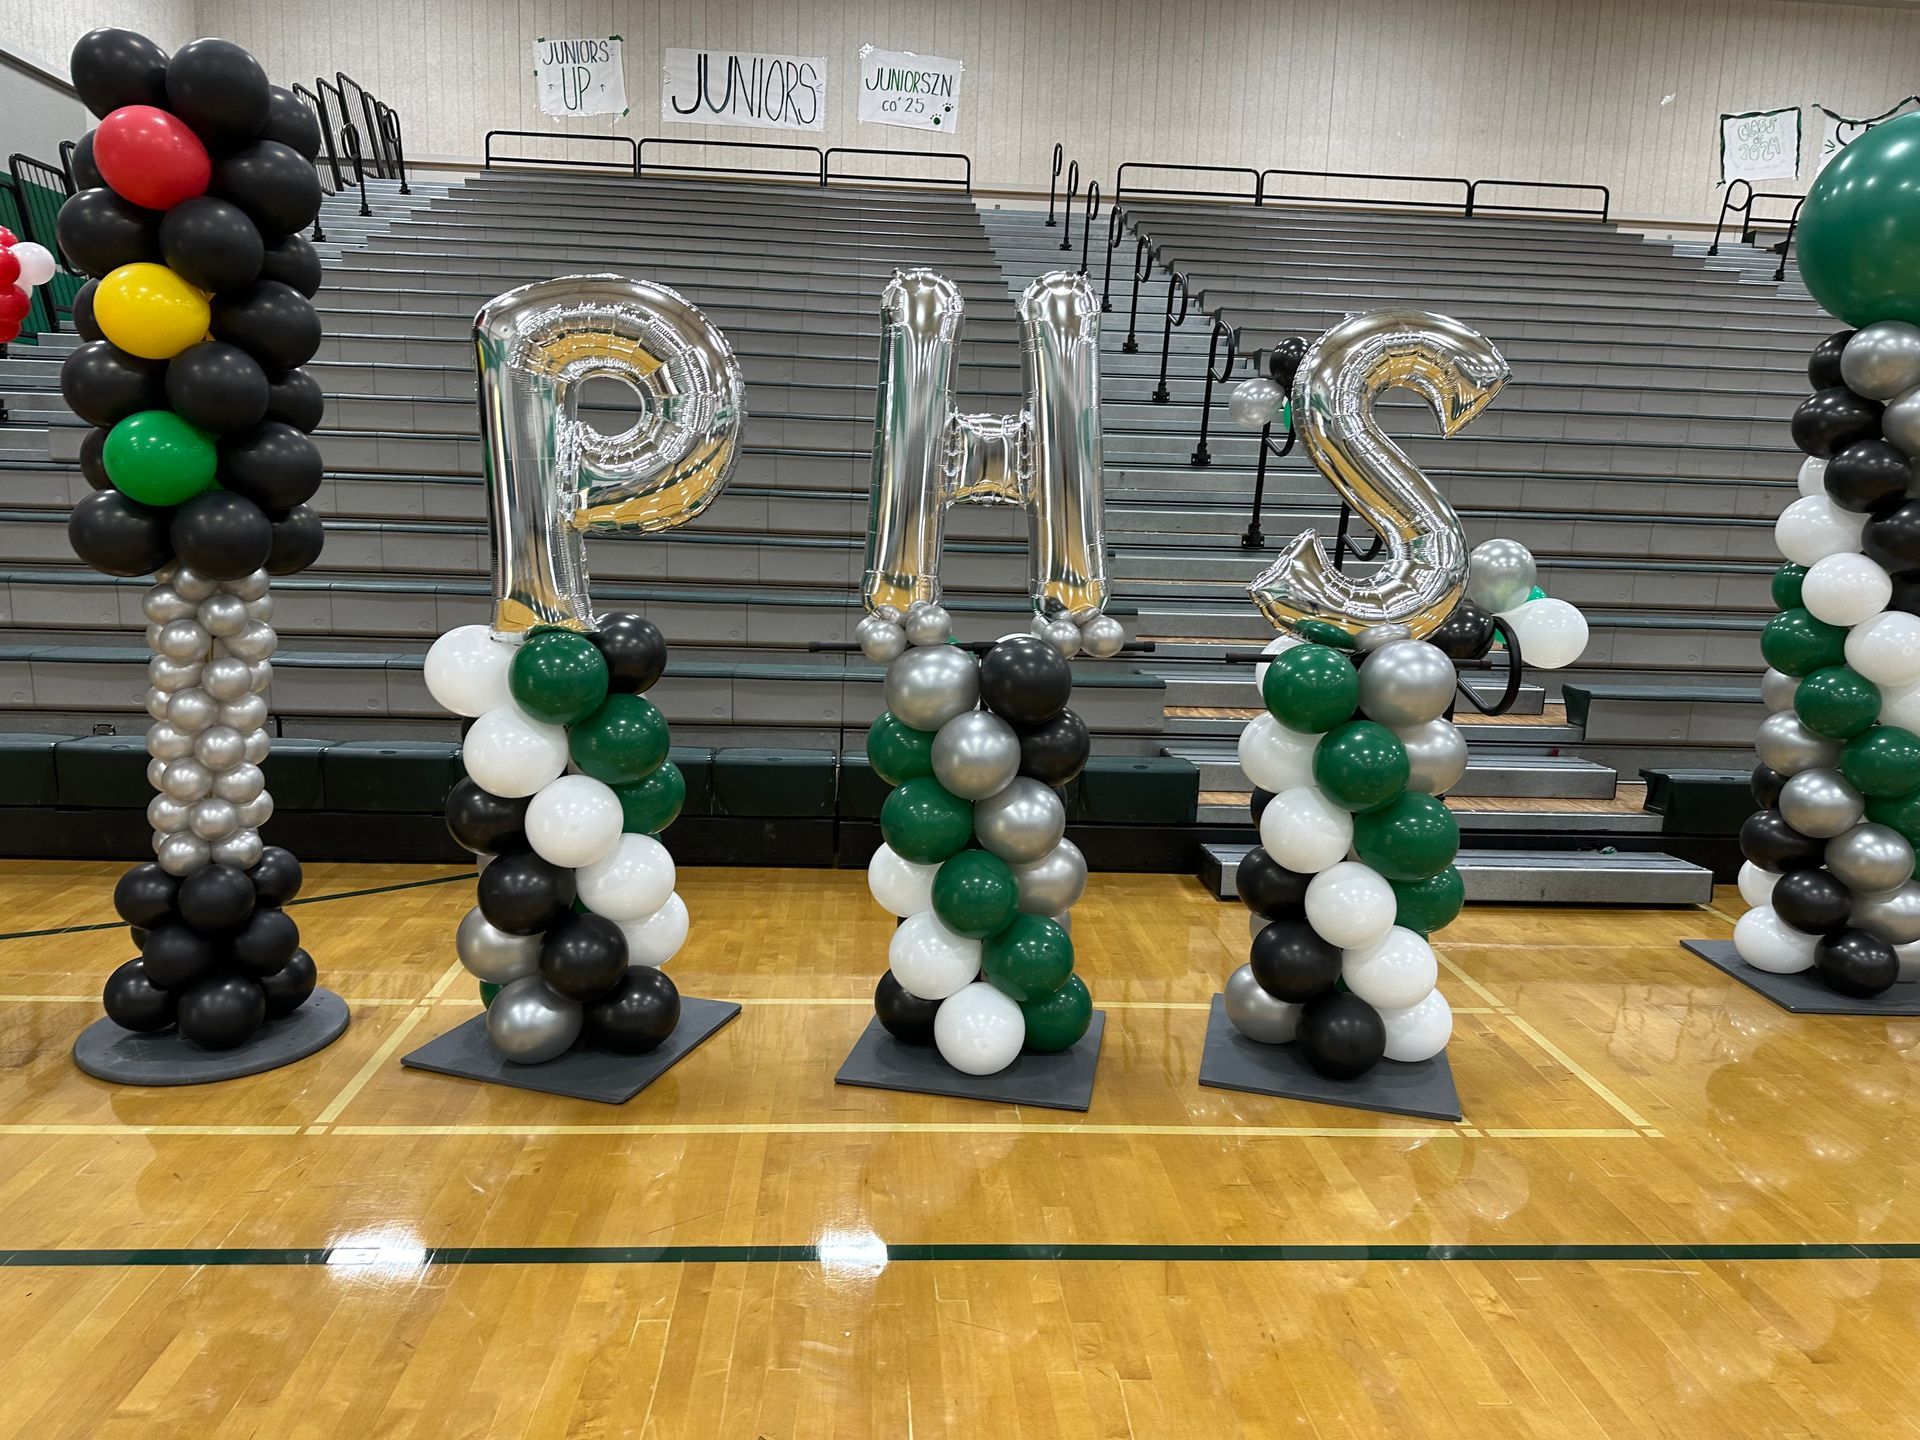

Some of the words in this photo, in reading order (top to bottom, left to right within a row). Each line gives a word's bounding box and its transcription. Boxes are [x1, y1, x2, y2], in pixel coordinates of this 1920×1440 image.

[542, 40, 610, 66] JUNIORS
[562, 67, 591, 111] UP
[672, 53, 817, 125] JUNIORS
[865, 67, 953, 97] JUNIORSZN
[1737, 117, 1778, 142] CLASS
[1738, 136, 1781, 161] 2024
